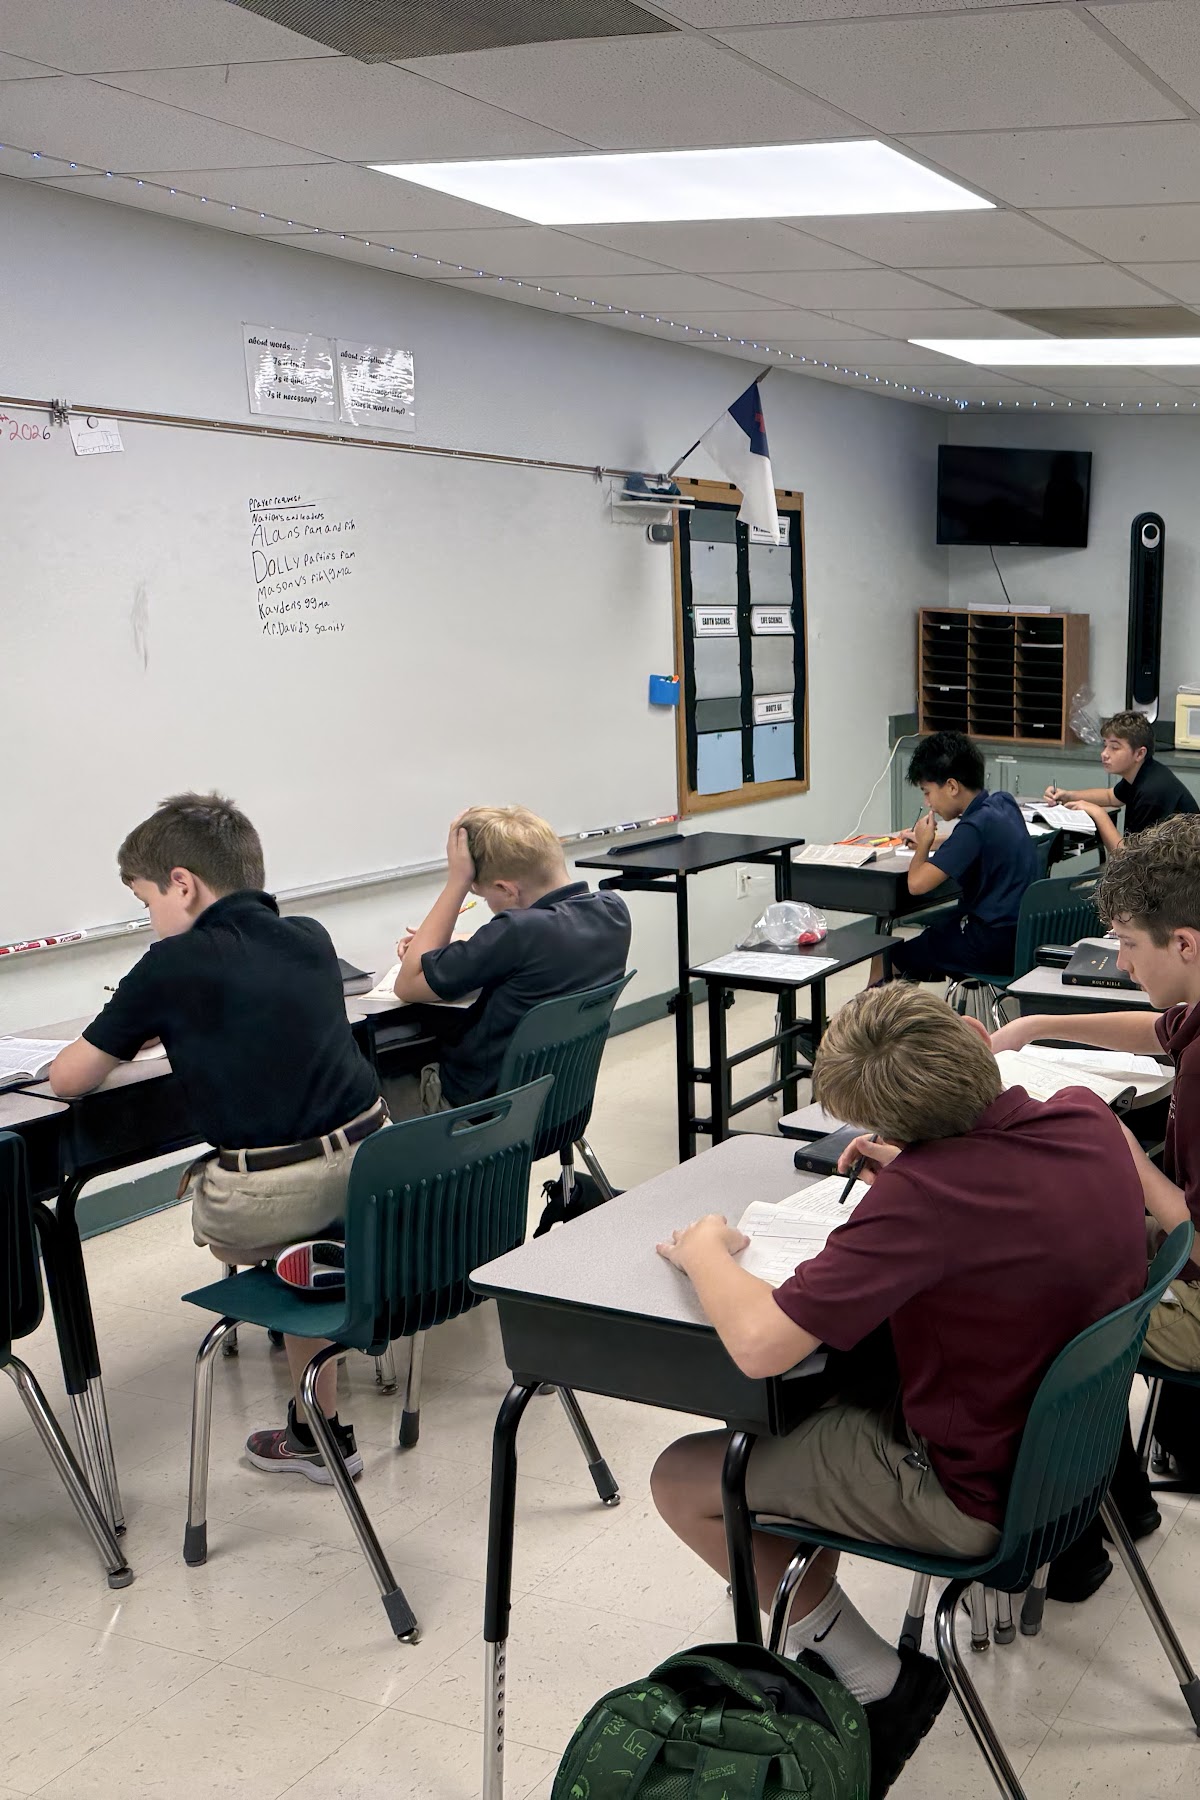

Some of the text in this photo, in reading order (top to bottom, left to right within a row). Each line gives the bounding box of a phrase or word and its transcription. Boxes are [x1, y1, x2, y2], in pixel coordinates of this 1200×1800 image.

[283, 393, 317, 404] necessary?
[9, 420, 51, 441] 2026
[324, 522, 342, 534] and
[702, 617, 731, 626] EARTH SCIENCE
